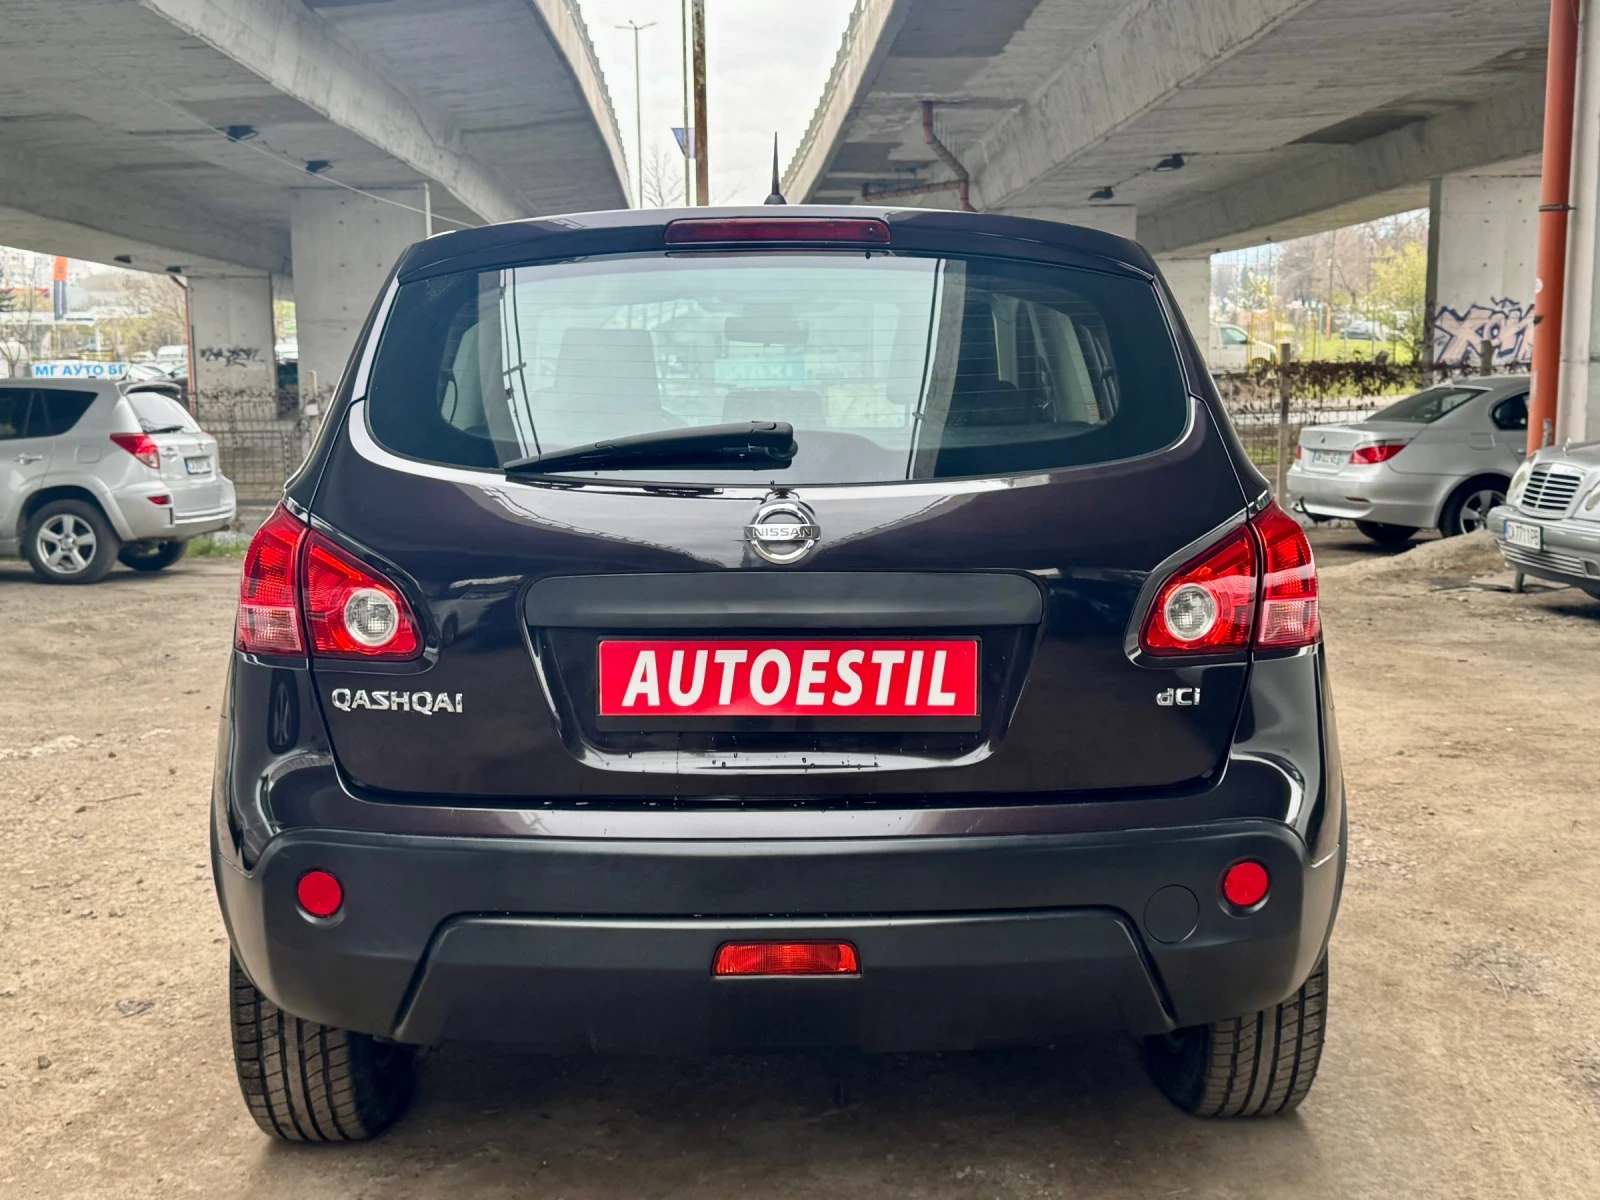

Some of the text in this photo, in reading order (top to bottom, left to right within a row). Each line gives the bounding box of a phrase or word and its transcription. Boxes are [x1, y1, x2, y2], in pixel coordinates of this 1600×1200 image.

[35, 364, 126, 376] МГ АУТО БГ
[752, 527, 813, 538] NISSAN
[620, 648, 957, 707] AUTOESTIL
[331, 687, 463, 716] QASHQAI
[1156, 687, 1201, 706] dCi
